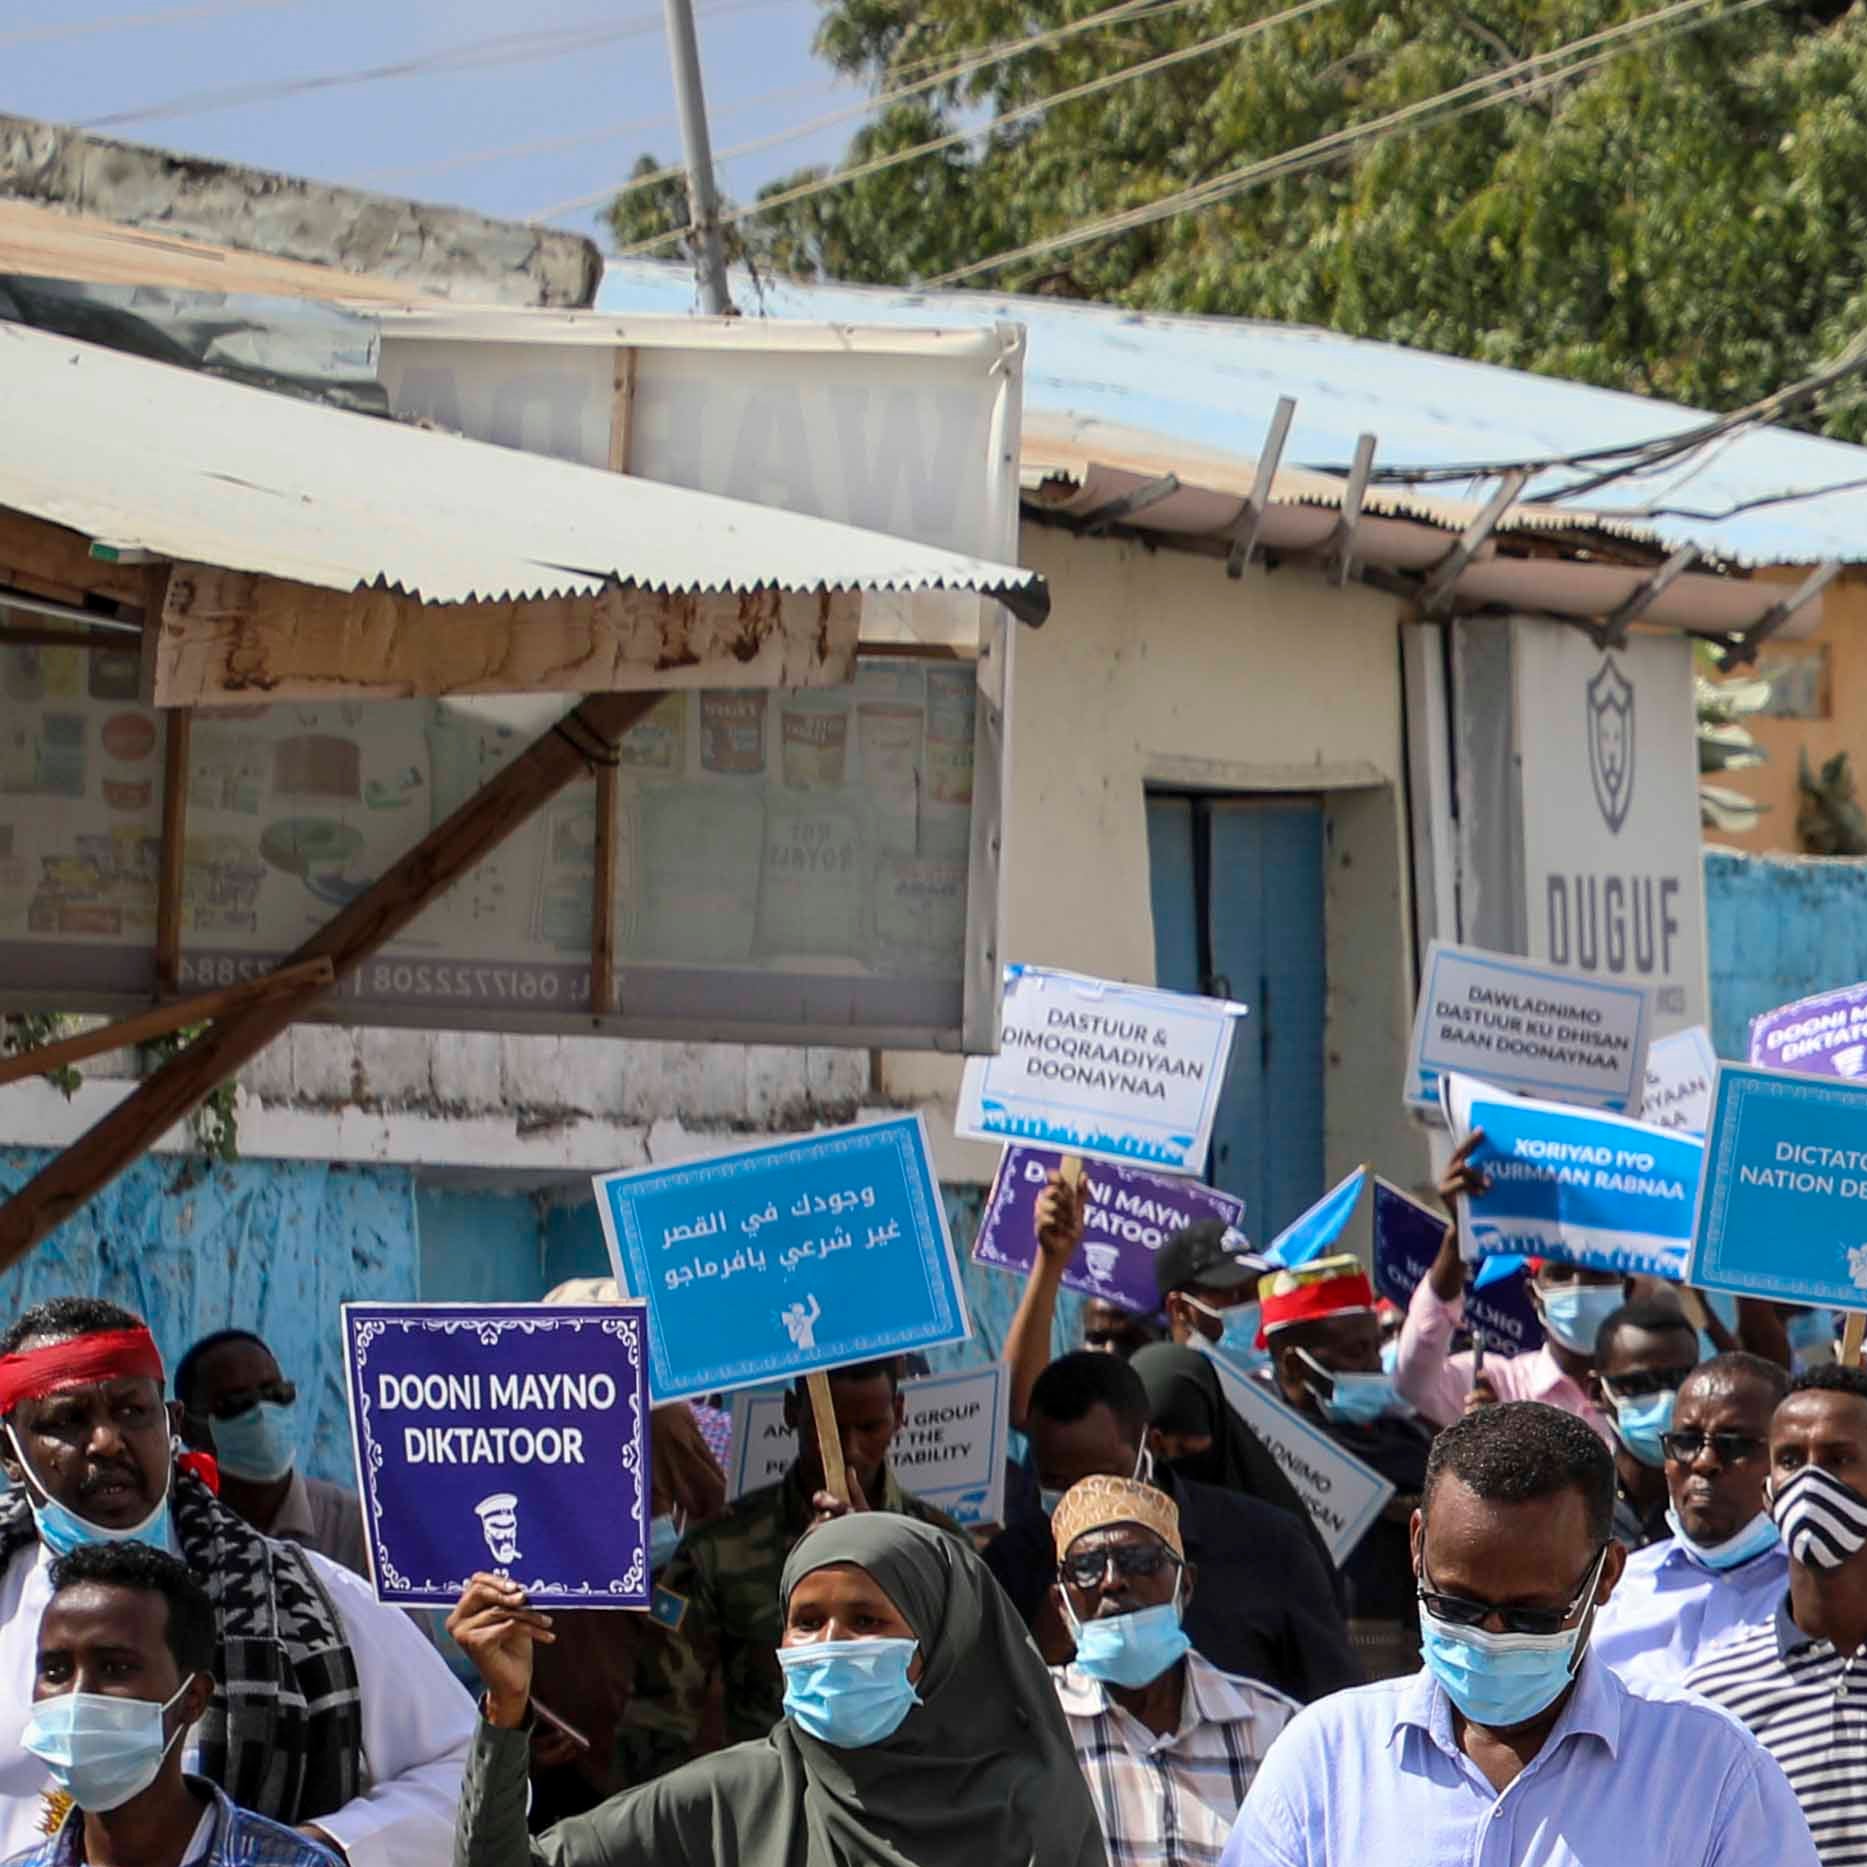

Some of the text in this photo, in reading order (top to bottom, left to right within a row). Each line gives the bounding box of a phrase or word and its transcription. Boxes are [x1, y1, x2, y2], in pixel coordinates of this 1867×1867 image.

[1547, 875, 1679, 975] DUGUF
[1468, 986, 1602, 1025] DAWLADNIMO
[1047, 1007, 1167, 1046] DASTUUR &
[1436, 1002, 1629, 1051] DASTUUR KU DHISAN
[1767, 1009, 1848, 1050] DOONI
[1001, 1026, 1205, 1080] DIMOQRAADIYAAN
[1440, 1025, 1620, 1071] BAAN DOONAYNAA
[1026, 1057, 1167, 1100] DOONAYNAA
[1513, 1136, 1656, 1173] XORIYAD IYO
[1481, 1159, 1685, 1200] XURMAAN RABNAA
[1739, 1164, 1834, 1195] NATION
[662, 1185, 876, 1250] وجودك في القصر
[1115, 1190, 1190, 1231] MAYN
[664, 1217, 901, 1290] غير شرعي يافرماجو
[378, 1373, 617, 1411] DOONI MAYNO
[914, 1401, 981, 1427] GROUP
[404, 1427, 585, 1464] DIKTATOOR
[892, 1442, 972, 1467] TABILITY
